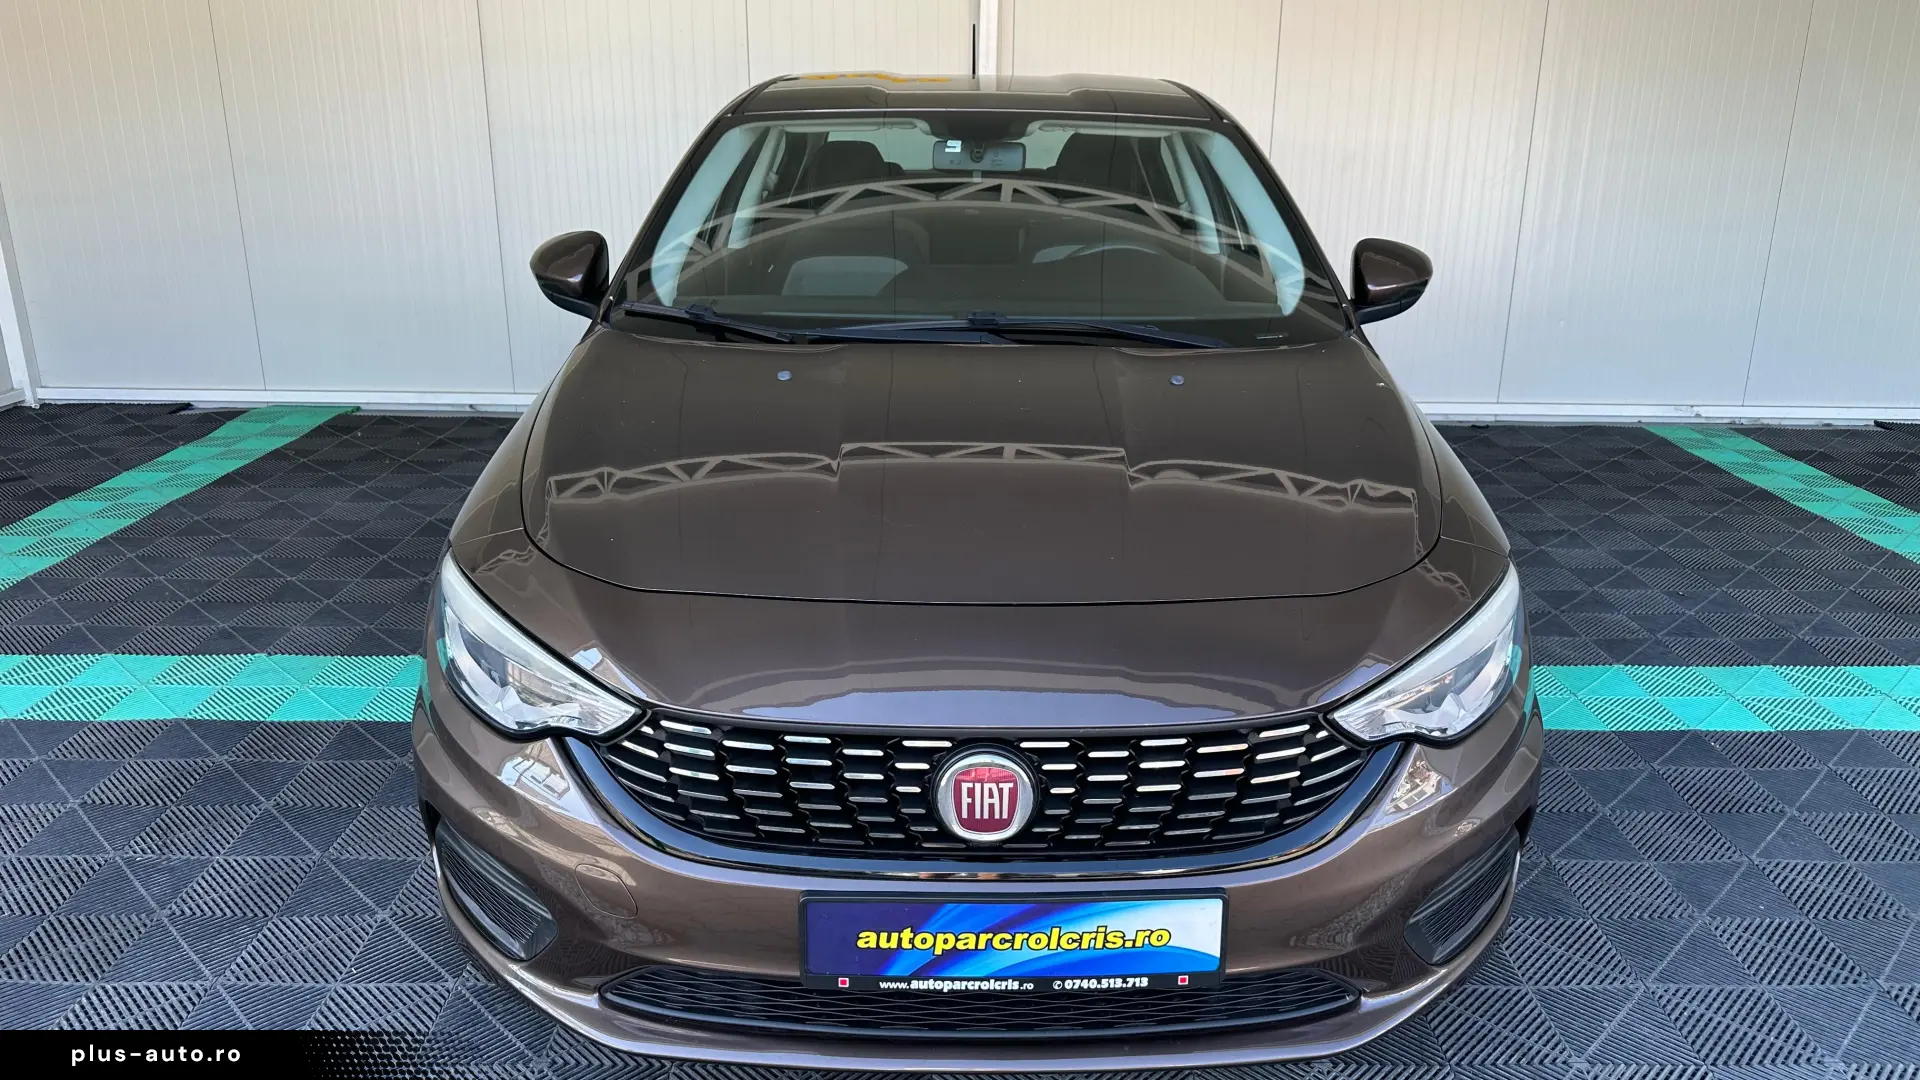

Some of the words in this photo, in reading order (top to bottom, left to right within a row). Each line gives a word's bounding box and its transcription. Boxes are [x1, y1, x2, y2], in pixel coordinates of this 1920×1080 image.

[961, 782, 1014, 819] FIAT
[856, 926, 1171, 954] autoparcrolcris.ro
[1064, 976, 1149, 990] 0740.513.713
